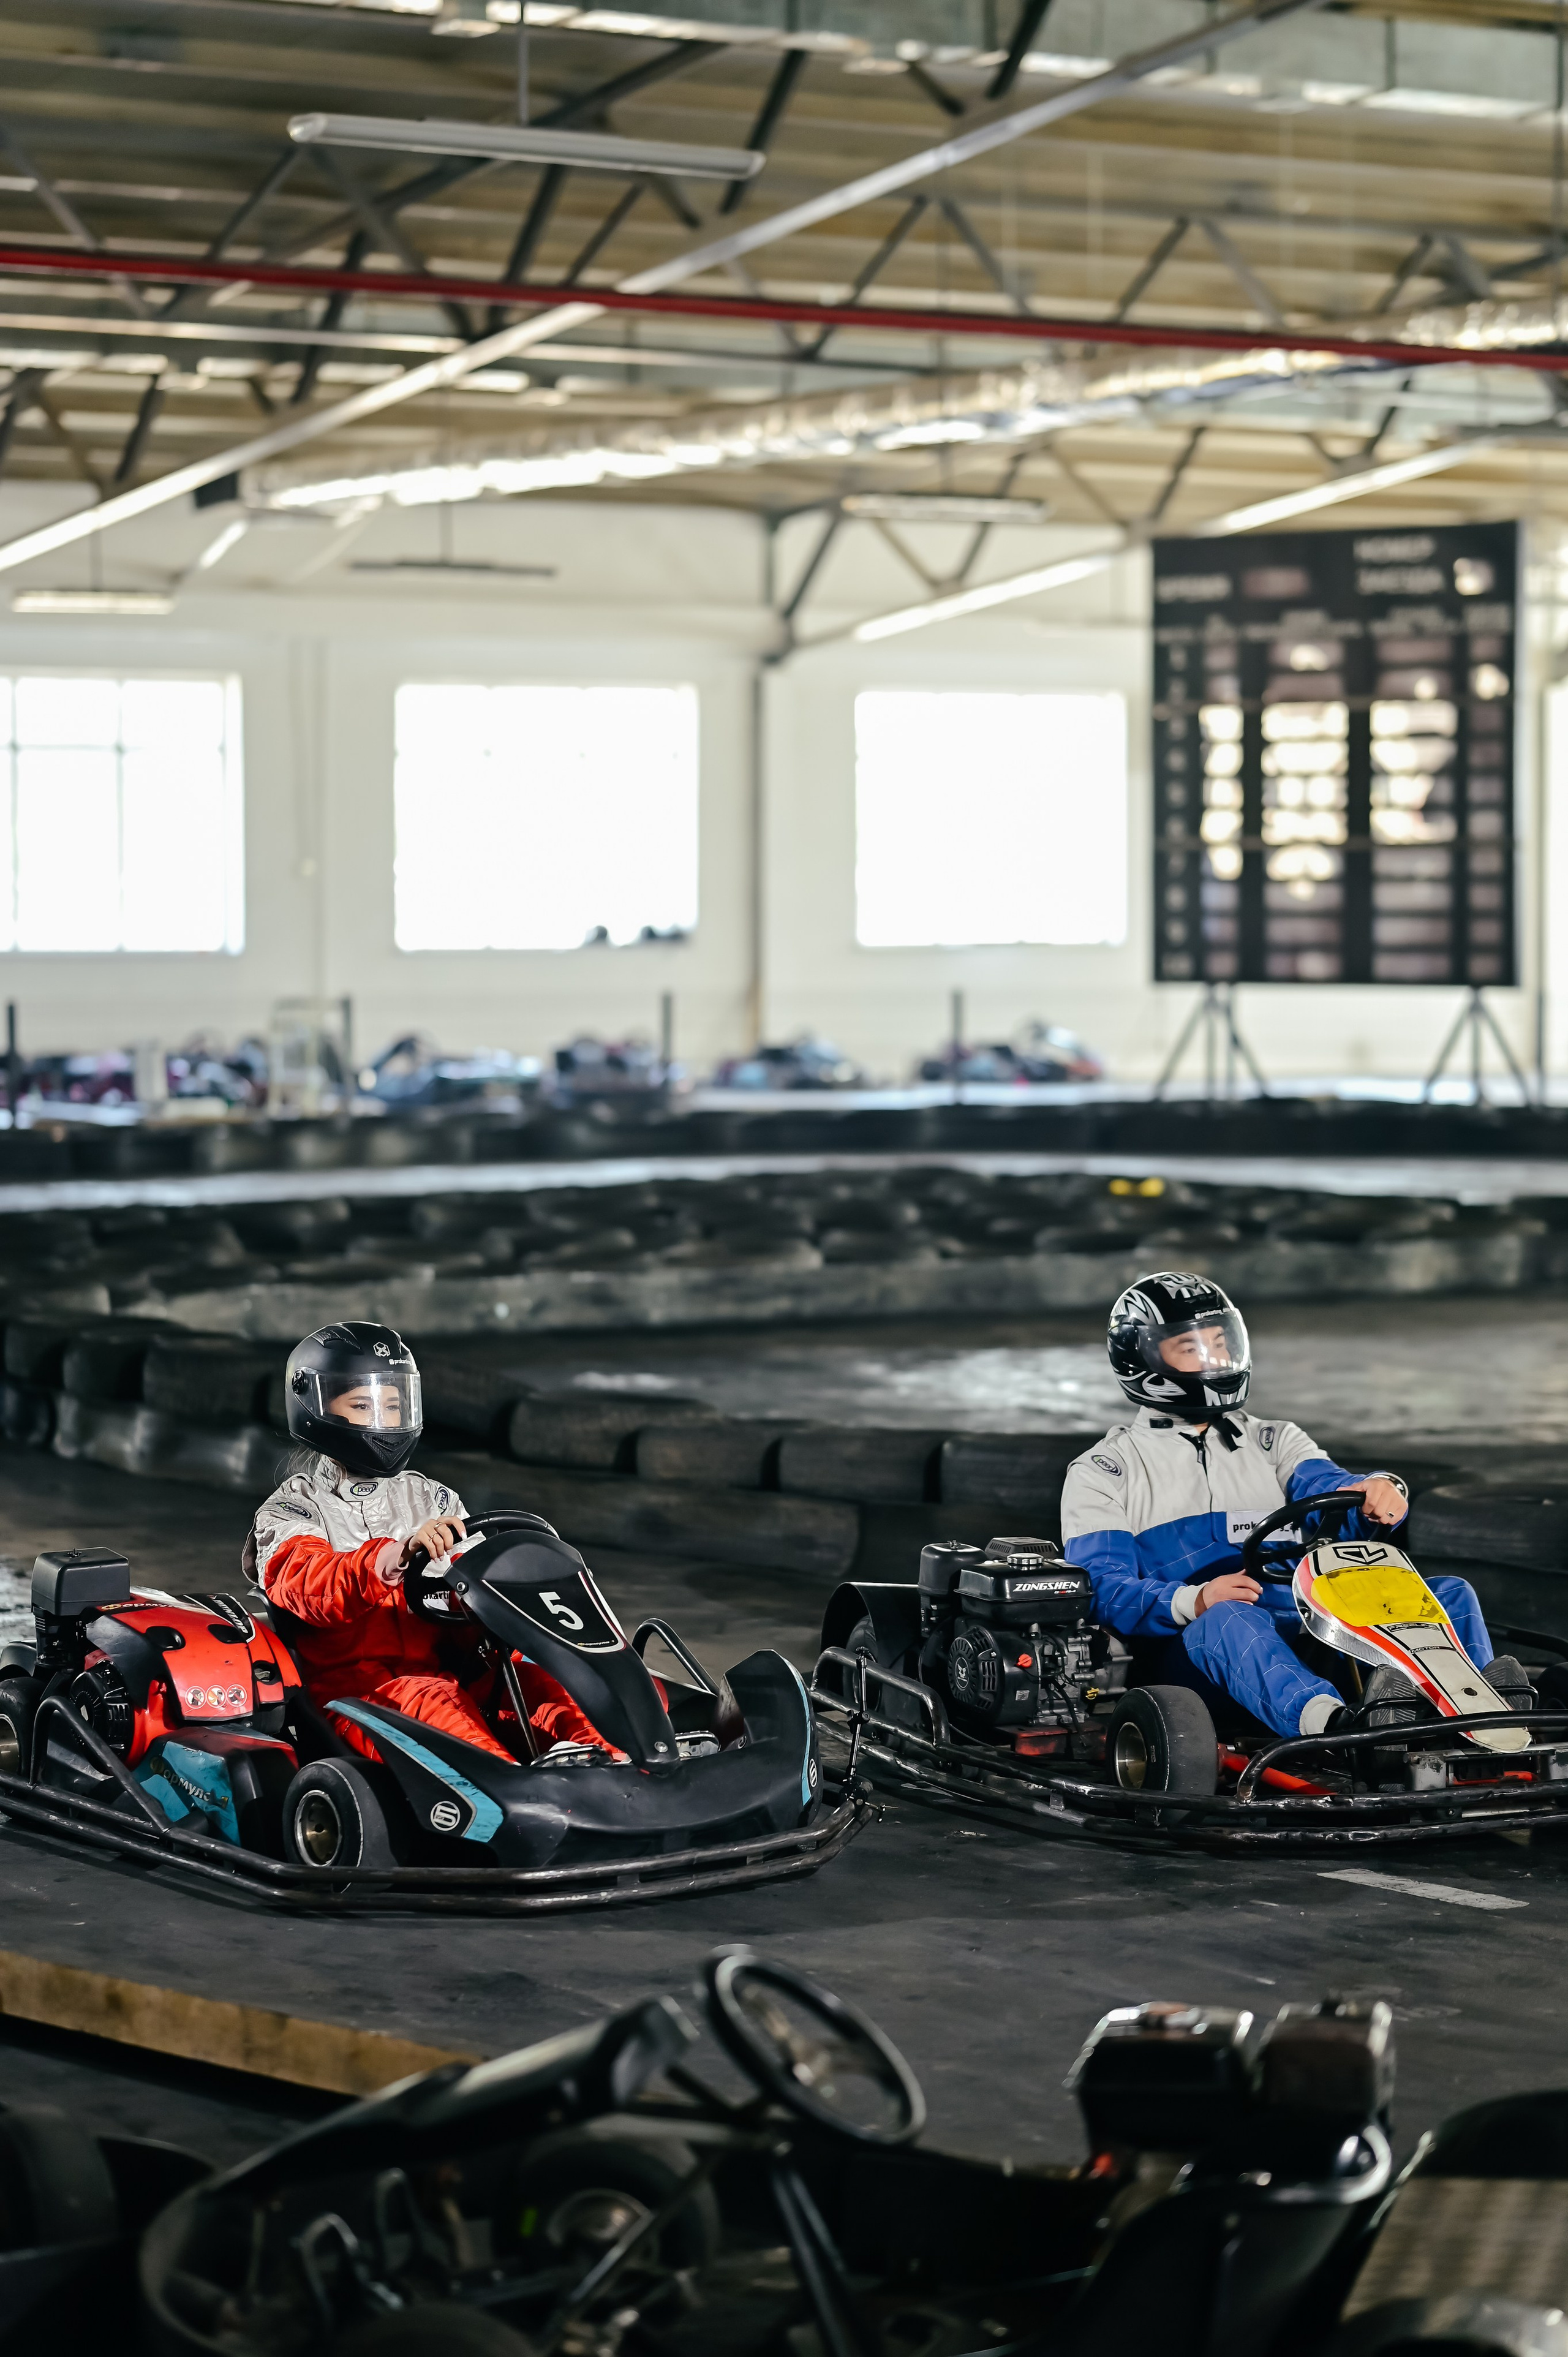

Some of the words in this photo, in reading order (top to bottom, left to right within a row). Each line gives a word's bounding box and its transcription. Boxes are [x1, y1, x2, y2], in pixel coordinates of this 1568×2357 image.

[1012, 1581, 1080, 1591] ZONGSHEN
[212, 1599, 249, 1634] DUNLOP
[538, 1591, 584, 1631] 5
